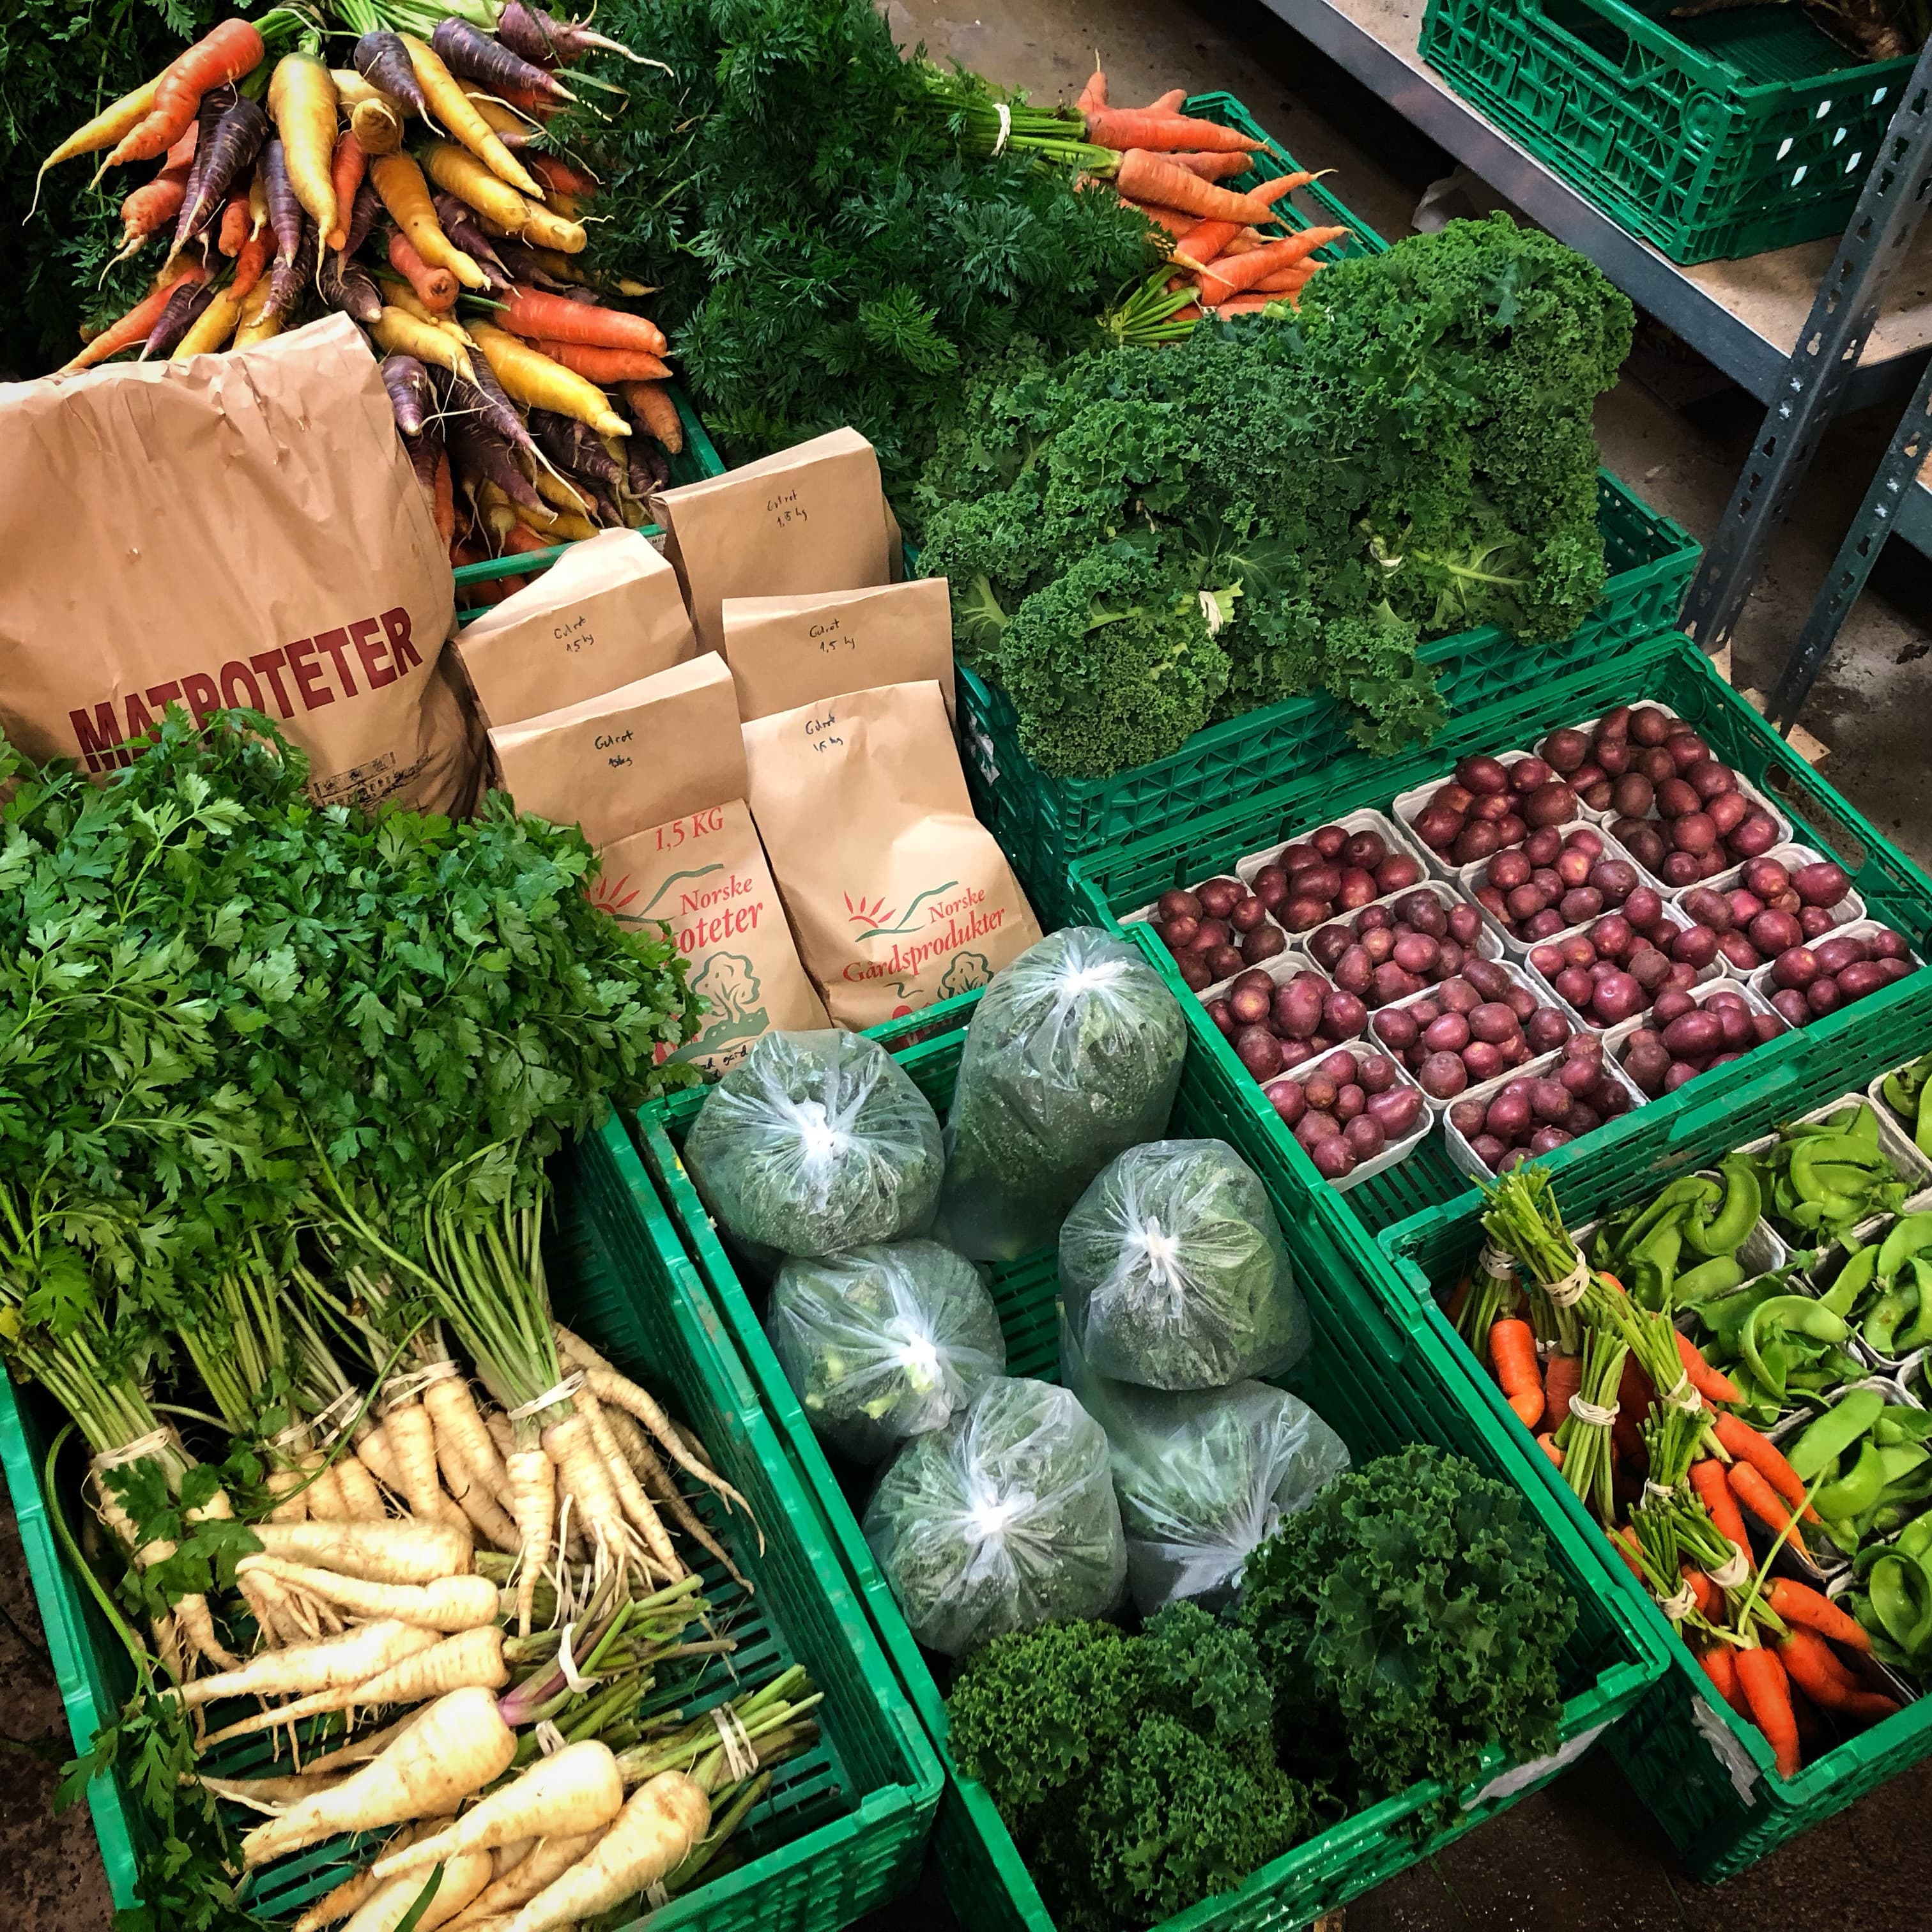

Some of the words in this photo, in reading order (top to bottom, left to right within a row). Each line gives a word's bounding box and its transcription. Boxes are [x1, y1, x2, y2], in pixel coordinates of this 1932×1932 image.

[595, 730, 634, 750] Gulrot
[656, 820, 685, 852] 1,5
[693, 806, 723, 838] KG
[680, 875, 753, 916] Norske
[928, 887, 985, 924] Norske
[661, 902, 763, 966] oteter
[842, 907, 1005, 983] Gårdsprodukter
